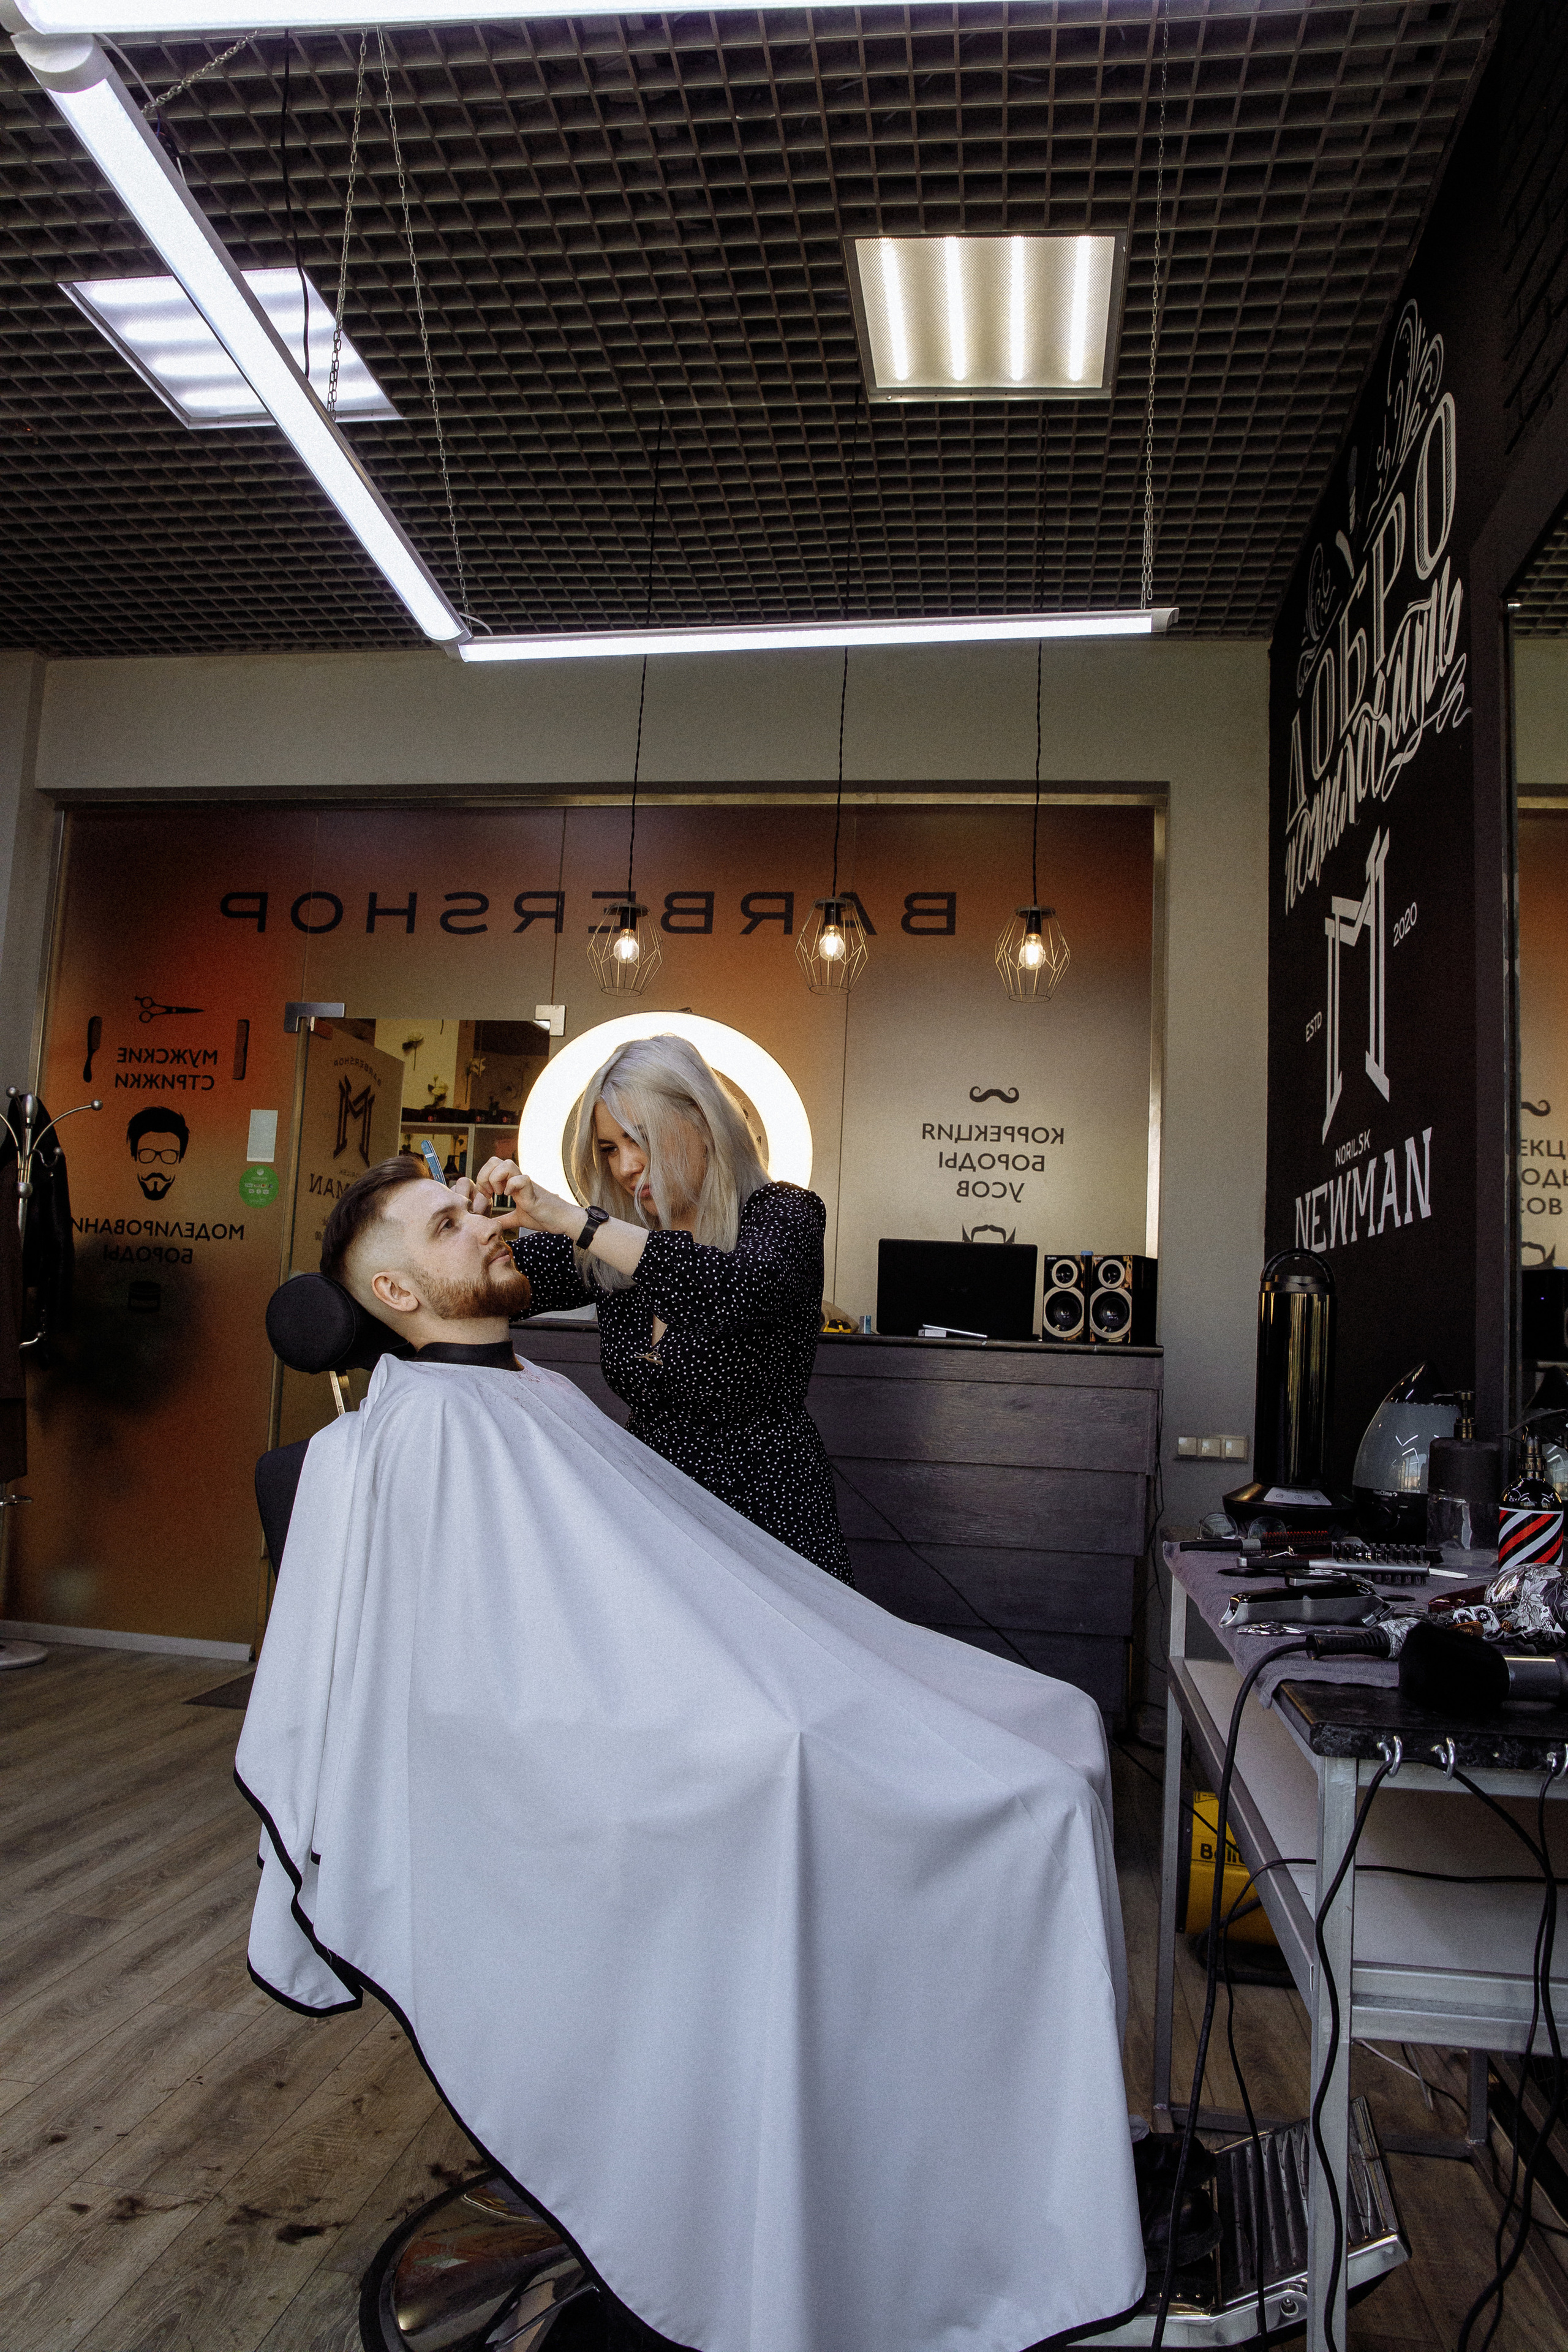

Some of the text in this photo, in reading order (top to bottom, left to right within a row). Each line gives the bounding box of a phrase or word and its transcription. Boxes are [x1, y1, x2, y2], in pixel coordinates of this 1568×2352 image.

[1393, 902, 1417, 947] 2020
[1306, 1011, 1322, 1042] ESTD
[1335, 1128, 1371, 1167] NORILSK
[1294, 1126, 1432, 1259] NEWMAN
